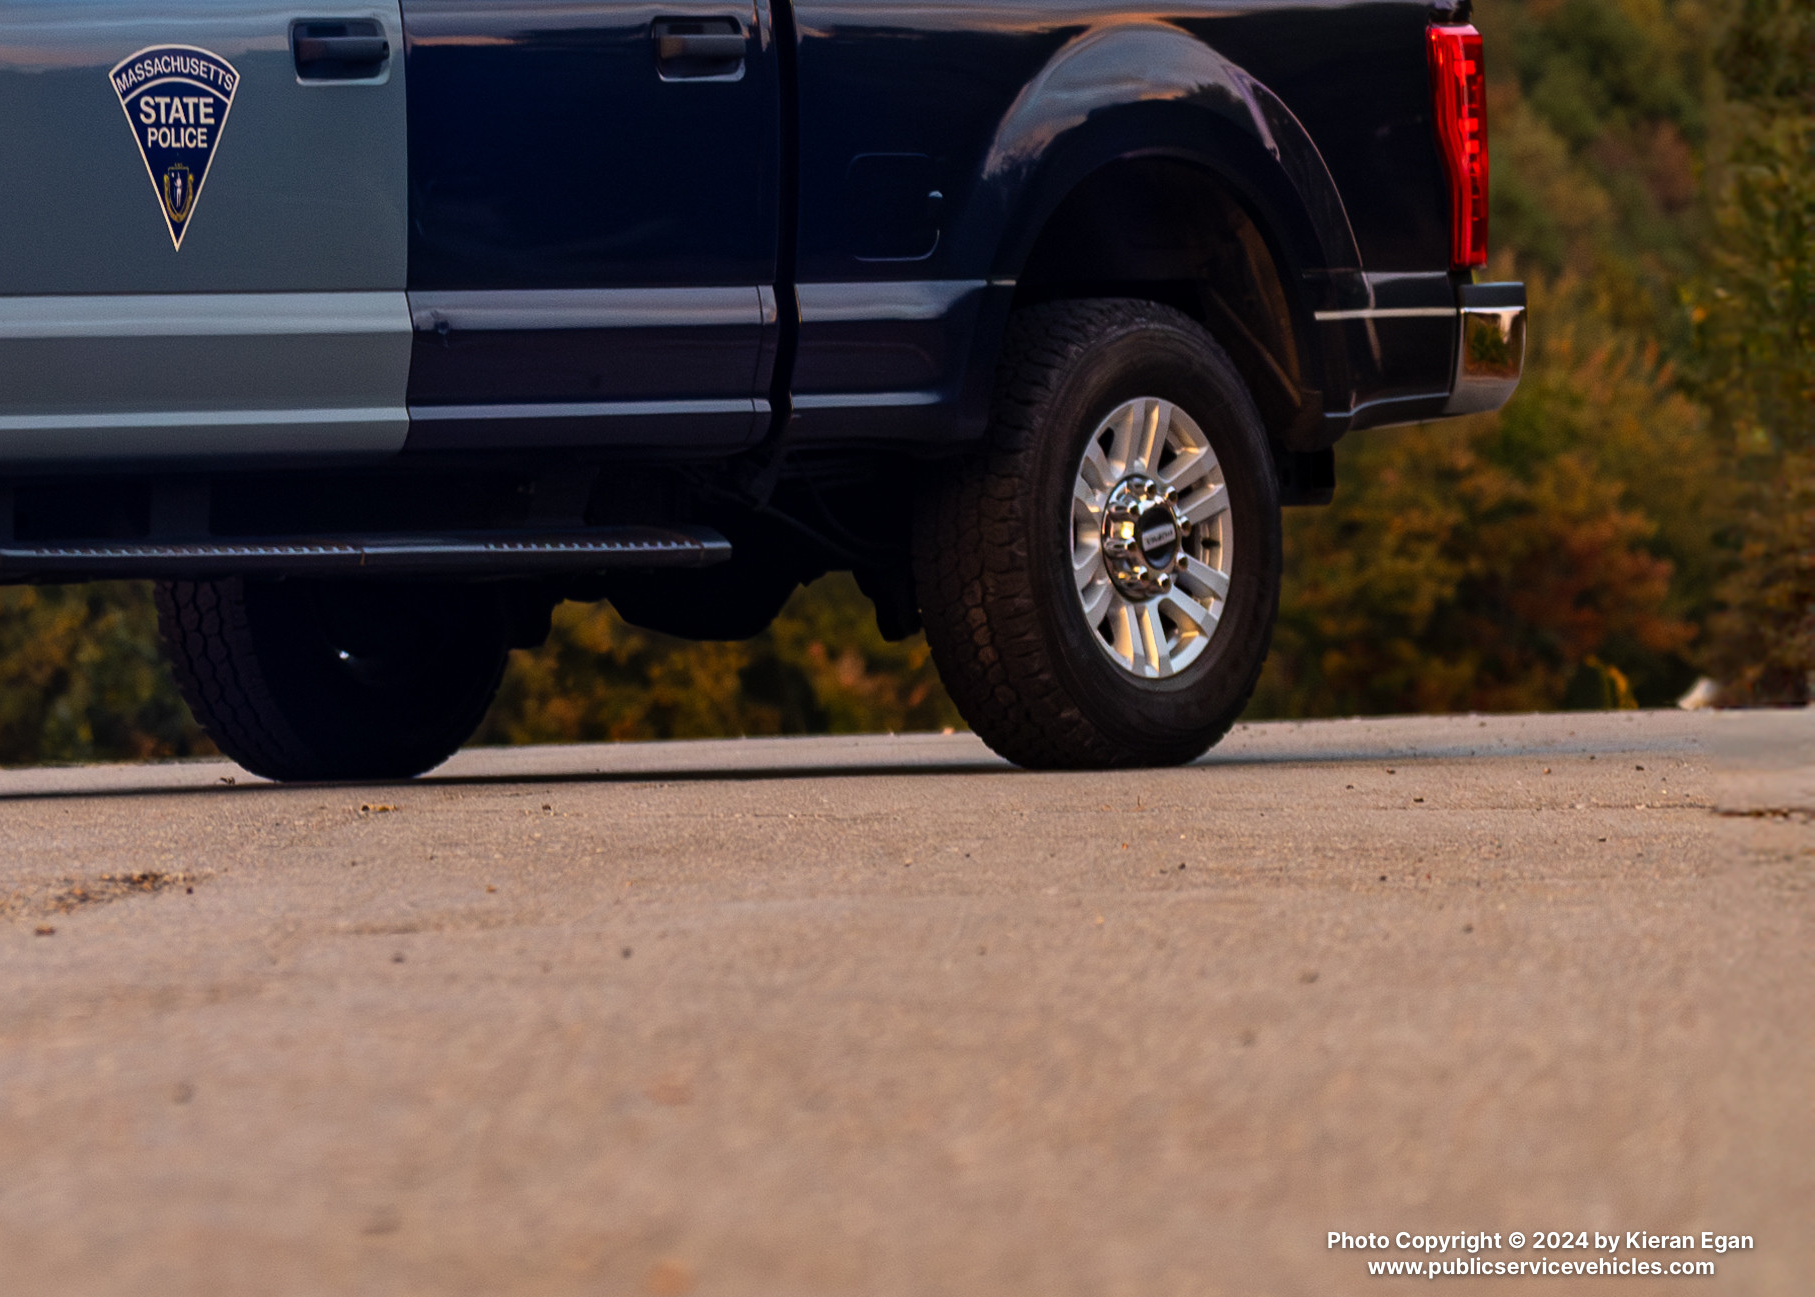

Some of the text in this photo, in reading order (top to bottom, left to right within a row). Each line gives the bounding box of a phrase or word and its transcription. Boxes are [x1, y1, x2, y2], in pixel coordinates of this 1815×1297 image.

[116, 55, 234, 94] MASSACHUSETTS
[139, 95, 215, 124] STATE
[147, 126, 208, 148] POLICE
